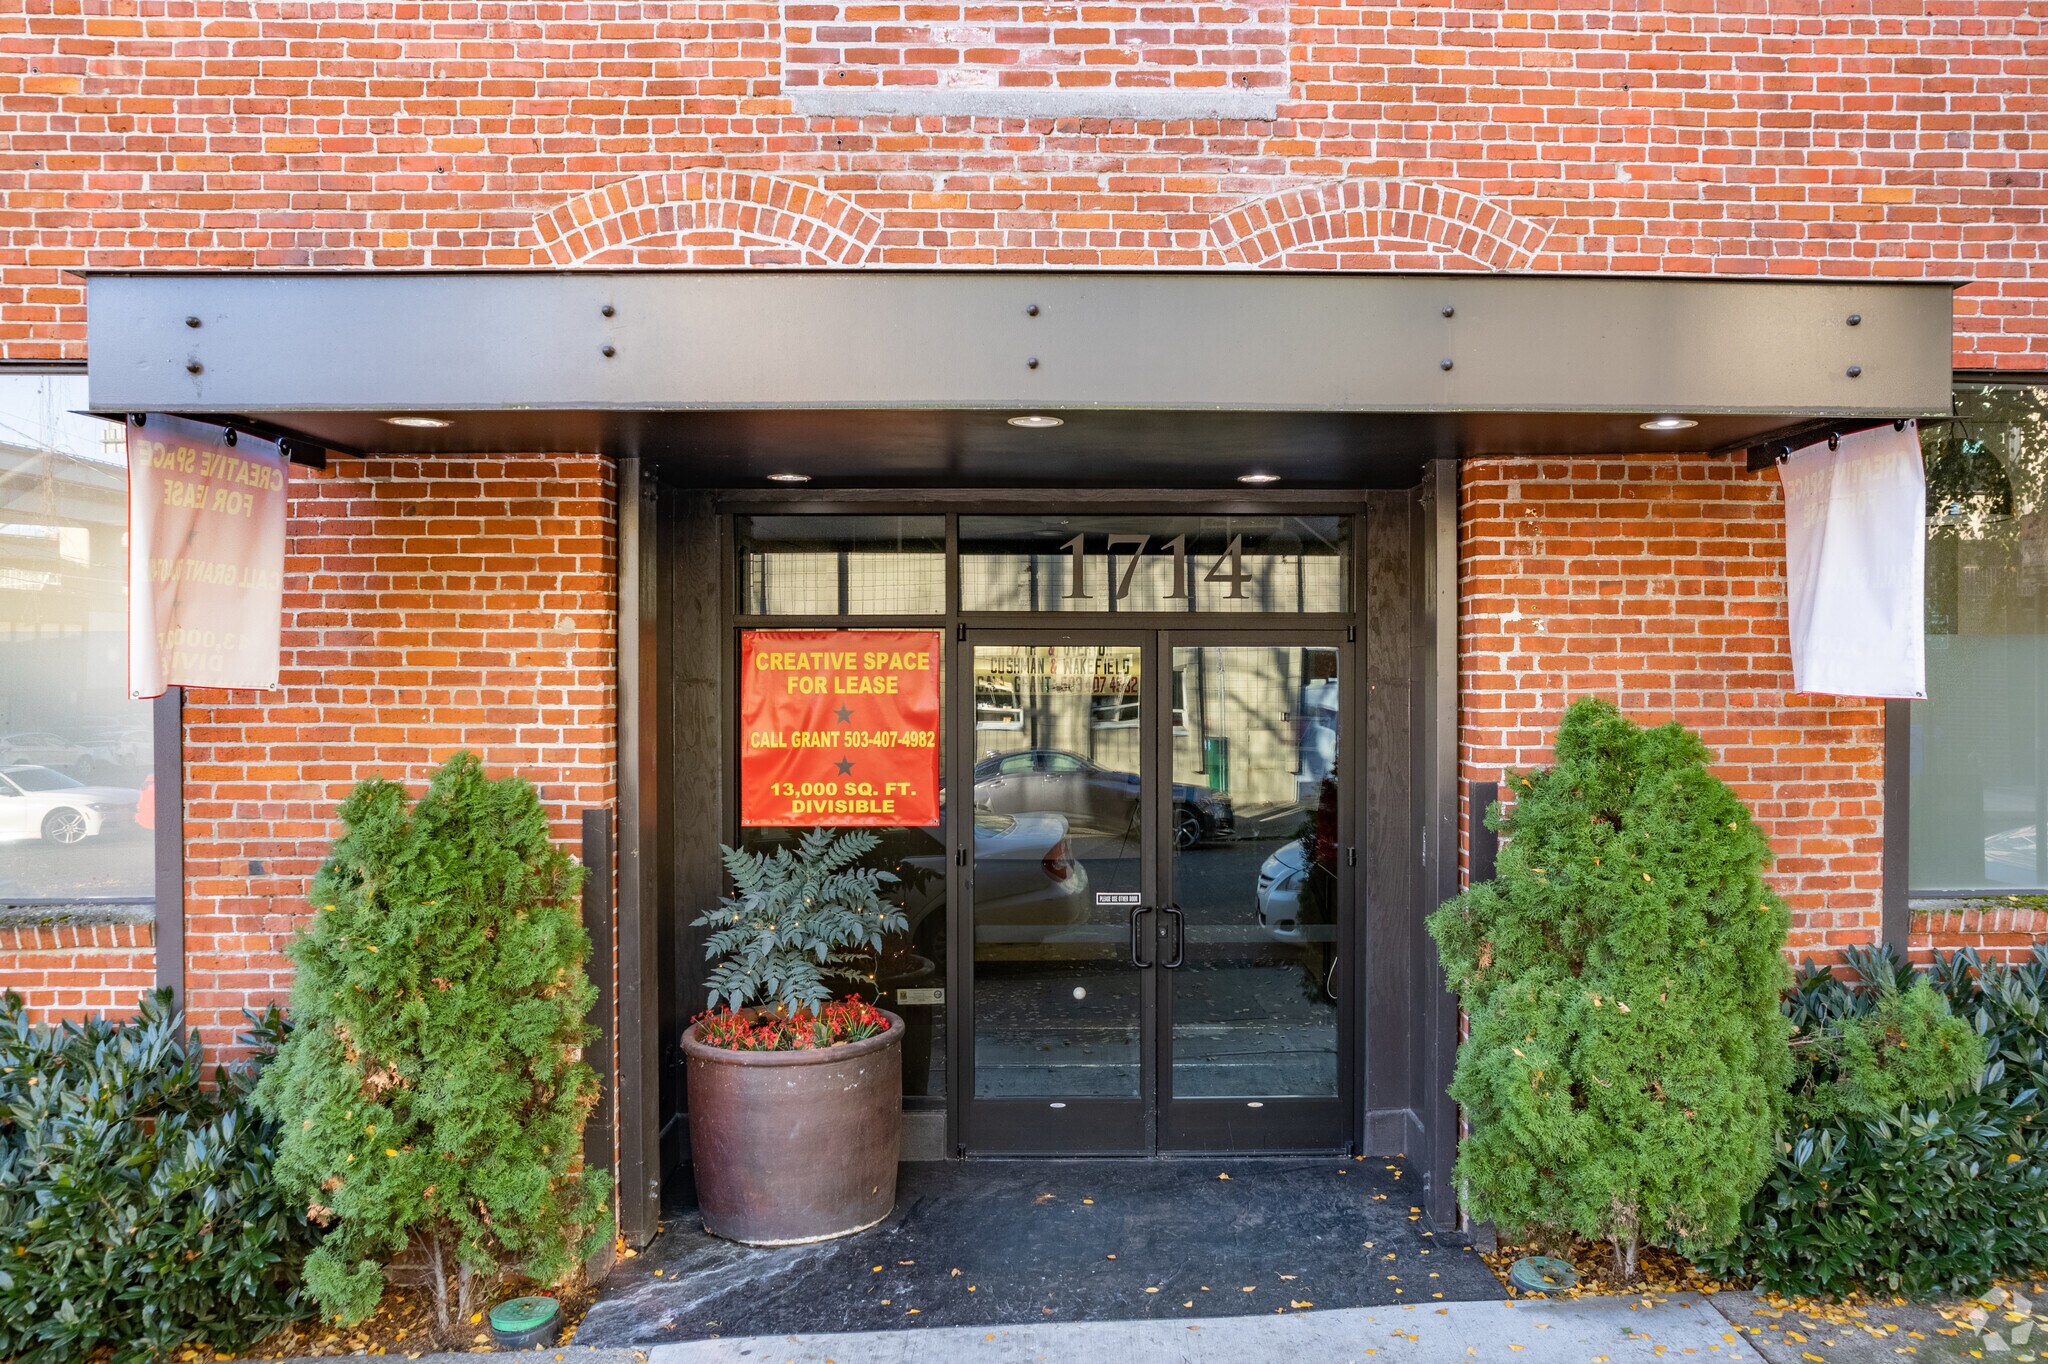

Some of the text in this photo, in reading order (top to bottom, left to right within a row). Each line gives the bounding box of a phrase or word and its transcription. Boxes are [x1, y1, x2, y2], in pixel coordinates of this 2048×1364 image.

[1060, 533, 1252, 600] 1714
[755, 652, 930, 671] CREATIVE SPACE
[991, 657, 1130, 675] CUSHMAN & WAKEFIELD
[787, 676, 898, 694] FOR LEASE
[1014, 675, 1052, 693] GANT
[751, 731, 935, 748] CALL GRANT 503-407-4982
[771, 782, 917, 799] 13,000 SQ. FT.
[792, 799, 895, 814] DIVISIBLE
